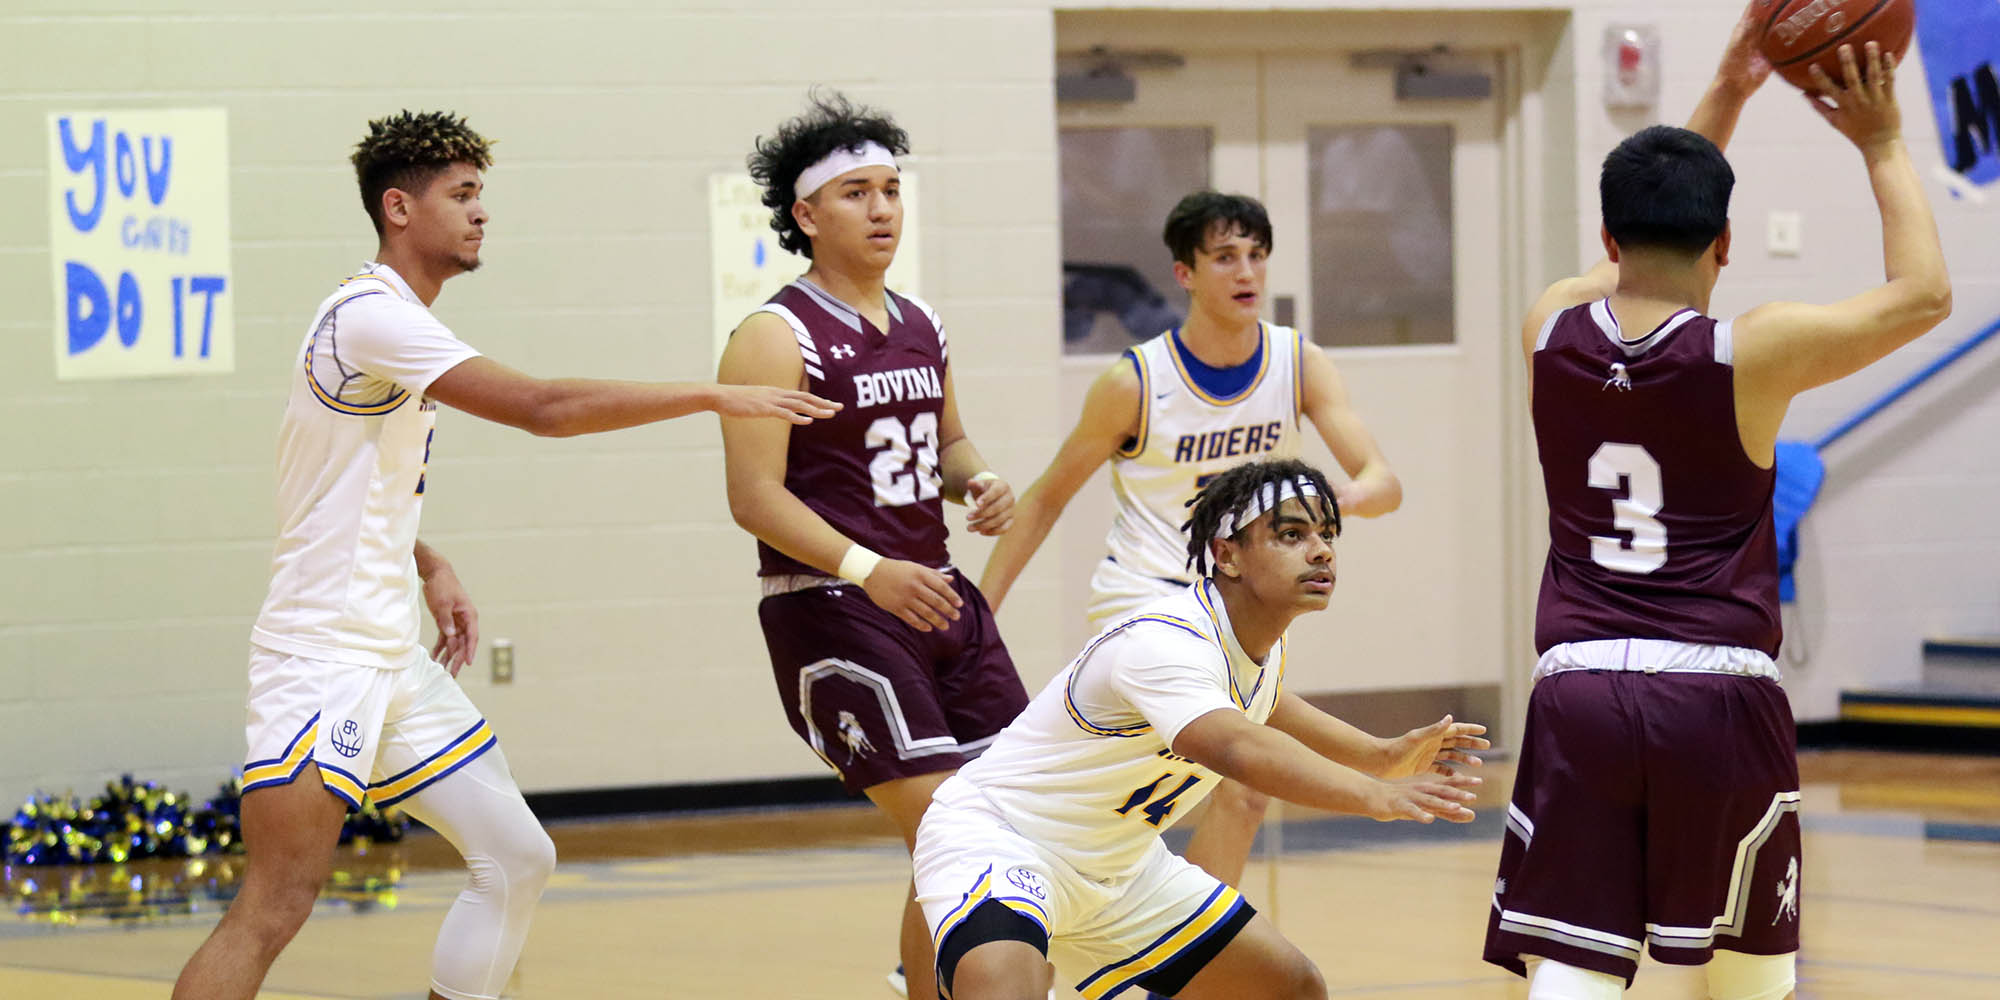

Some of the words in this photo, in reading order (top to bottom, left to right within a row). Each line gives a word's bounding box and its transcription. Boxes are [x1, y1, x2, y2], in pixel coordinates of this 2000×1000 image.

[58, 117, 173, 232] YOU
[65, 261, 142, 357] DO
[171, 276, 225, 357] IT
[853, 366, 943, 408] BOVINA
[865, 411, 944, 507] 22
[1174, 421, 1282, 463] RIDERS
[1588, 441, 1668, 574] 3
[1112, 770, 1204, 829] 14
